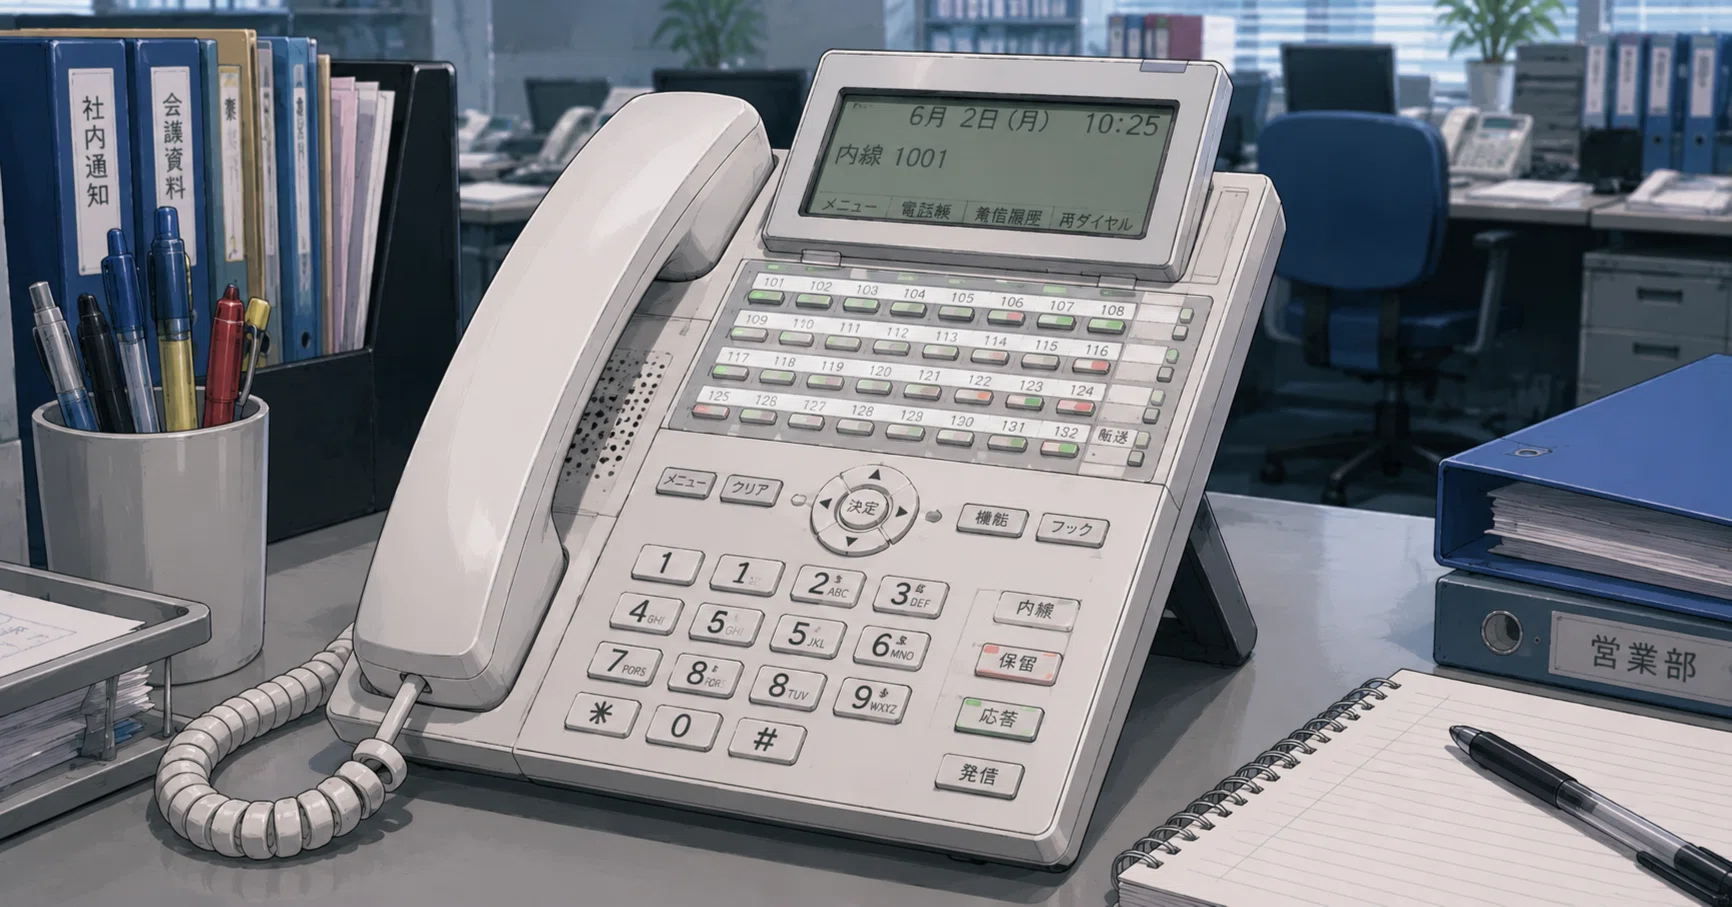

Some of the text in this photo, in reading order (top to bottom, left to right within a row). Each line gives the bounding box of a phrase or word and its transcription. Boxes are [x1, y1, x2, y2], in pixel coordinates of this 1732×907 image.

[909, 105, 947, 128] 6月
[1086, 112, 1160, 137] 10:25
[82, 95, 110, 208] 社内通知
[834, 144, 948, 169] 内線 1001
[821, 198, 877, 213] メニュー
[764, 278, 1125, 316] 101 102 103 104 105 106 107 108
[746, 314, 768, 325] 109
[840, 323, 861, 334] 111
[887, 327, 909, 338] 112
[936, 331, 958, 343] 113
[984, 336, 1007, 347] 114
[1035, 340, 1058, 352] 115
[1086, 345, 1109, 357] 116
[728, 352, 1094, 397] 117 118 119 120 121 122 123 124
[852, 405, 874, 416] 128
[1001, 420, 1025, 433] 131
[664, 474, 707, 488] メニュー
[732, 481, 769, 496] クリア
[846, 499, 880, 516] 決定
[1051, 520, 1094, 538] フック
[660, 552, 672, 574] 1
[732, 562, 750, 584] 1
[808, 572, 830, 594] 2
[827, 588, 849, 599] ABC
[890, 582, 911, 605] 3
[629, 600, 649, 623] 4
[910, 597, 931, 608] DEF
[646, 614, 665, 626] GHI
[707, 610, 728, 634] 5
[725, 625, 744, 636] GHI
[788, 621, 810, 646] 5
[807, 637, 825, 649] JKL
[872, 633, 892, 657] 6
[607, 648, 628, 672] 7
[890, 649, 914, 661] MNO
[998, 652, 1037, 674] 保留
[1591, 634, 1697, 683] 営業部
[687, 661, 708, 685] 8
[768, 673, 789, 698] 8
[788, 689, 809, 700] TUV
[852, 685, 873, 709] 9
[671, 713, 692, 738] 0
[753, 727, 778, 752] #
[959, 763, 999, 786] 発信
